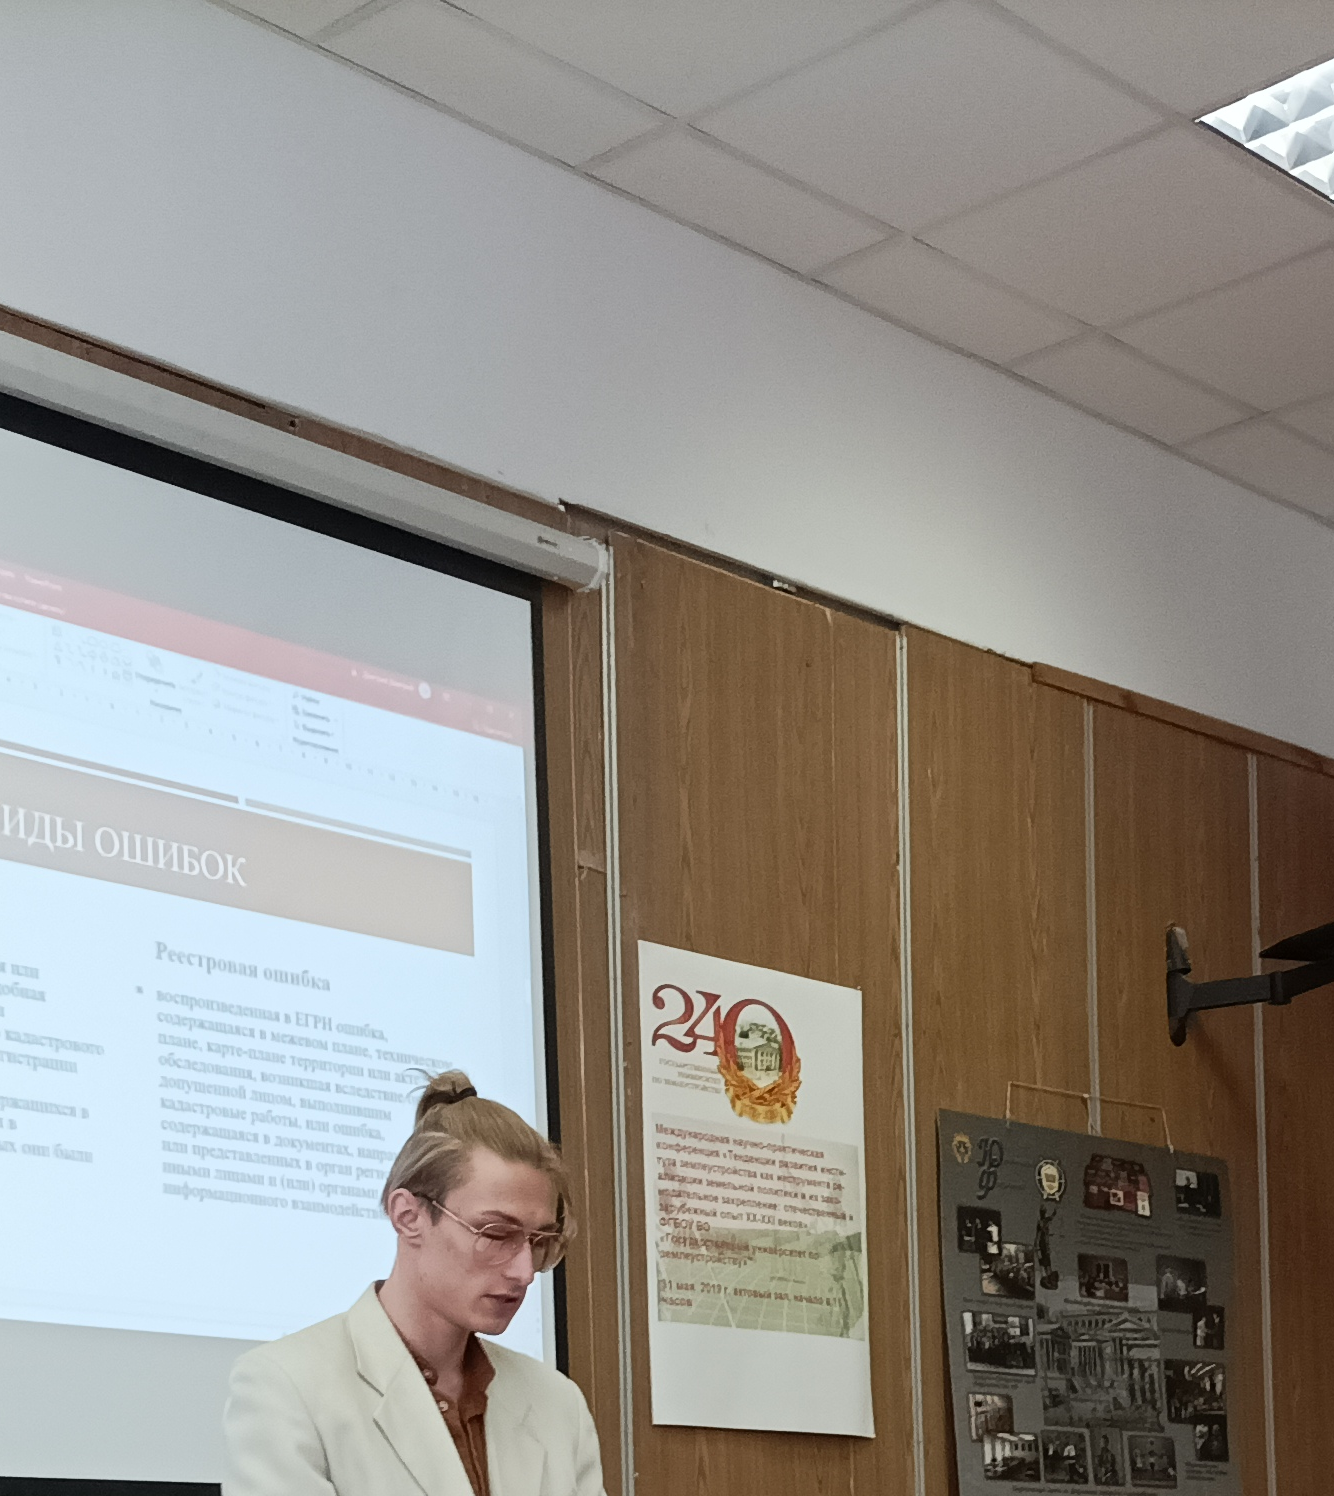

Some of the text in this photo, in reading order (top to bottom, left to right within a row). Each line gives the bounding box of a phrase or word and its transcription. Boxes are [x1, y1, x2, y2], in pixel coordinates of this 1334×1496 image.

[94, 825, 248, 887] ОШИБОК
[10, 963, 39, 979] или
[155, 940, 330, 991] Реестровая ошибка
[156, 989, 388, 1043] воспроизведенная в ЕГРН ошибка,
[156, 1011, 255, 1039] содержащаяся
[259, 1028, 266, 1040] в
[270, 1030, 328, 1051] межевом
[332, 1040, 372, 1059] плане,
[4, 1028, 104, 1055] кадастрового
[652, 983, 797, 1088] 240
[157, 1032, 202, 1052] плане,
[206, 1041, 286, 1064] карте-плане
[289, 1054, 363, 1078] территории
[368, 1067, 390, 1081] или
[158, 1075, 246, 1100] допущенной
[249, 1089, 296, 1106] лицом,
[299, 1097, 391, 1121] выполнившим
[260, 1071, 330, 1092] возникшая
[335, 1082, 403, 1103] вследствие
[8, 1117, 17, 1130] в
[81, 1106, 89, 1119] в
[160, 1096, 385, 1141] кадастровые работы, или ошибка,
[160, 1119, 259, 1143] содержащаяся
[263, 1133, 271, 1145] в
[655, 1122, 730, 1147] Международная
[21, 1143, 50, 1157] они
[53, 1142, 93, 1163] были
[162, 1139, 188, 1154] или
[191, 1144, 301, 1169] представленных
[305, 1159, 312, 1171] в
[315, 1161, 352, 1177] орган
[162, 1161, 378, 1203] иными лицами и (или) органами
[162, 1181, 288, 1208] информационного
